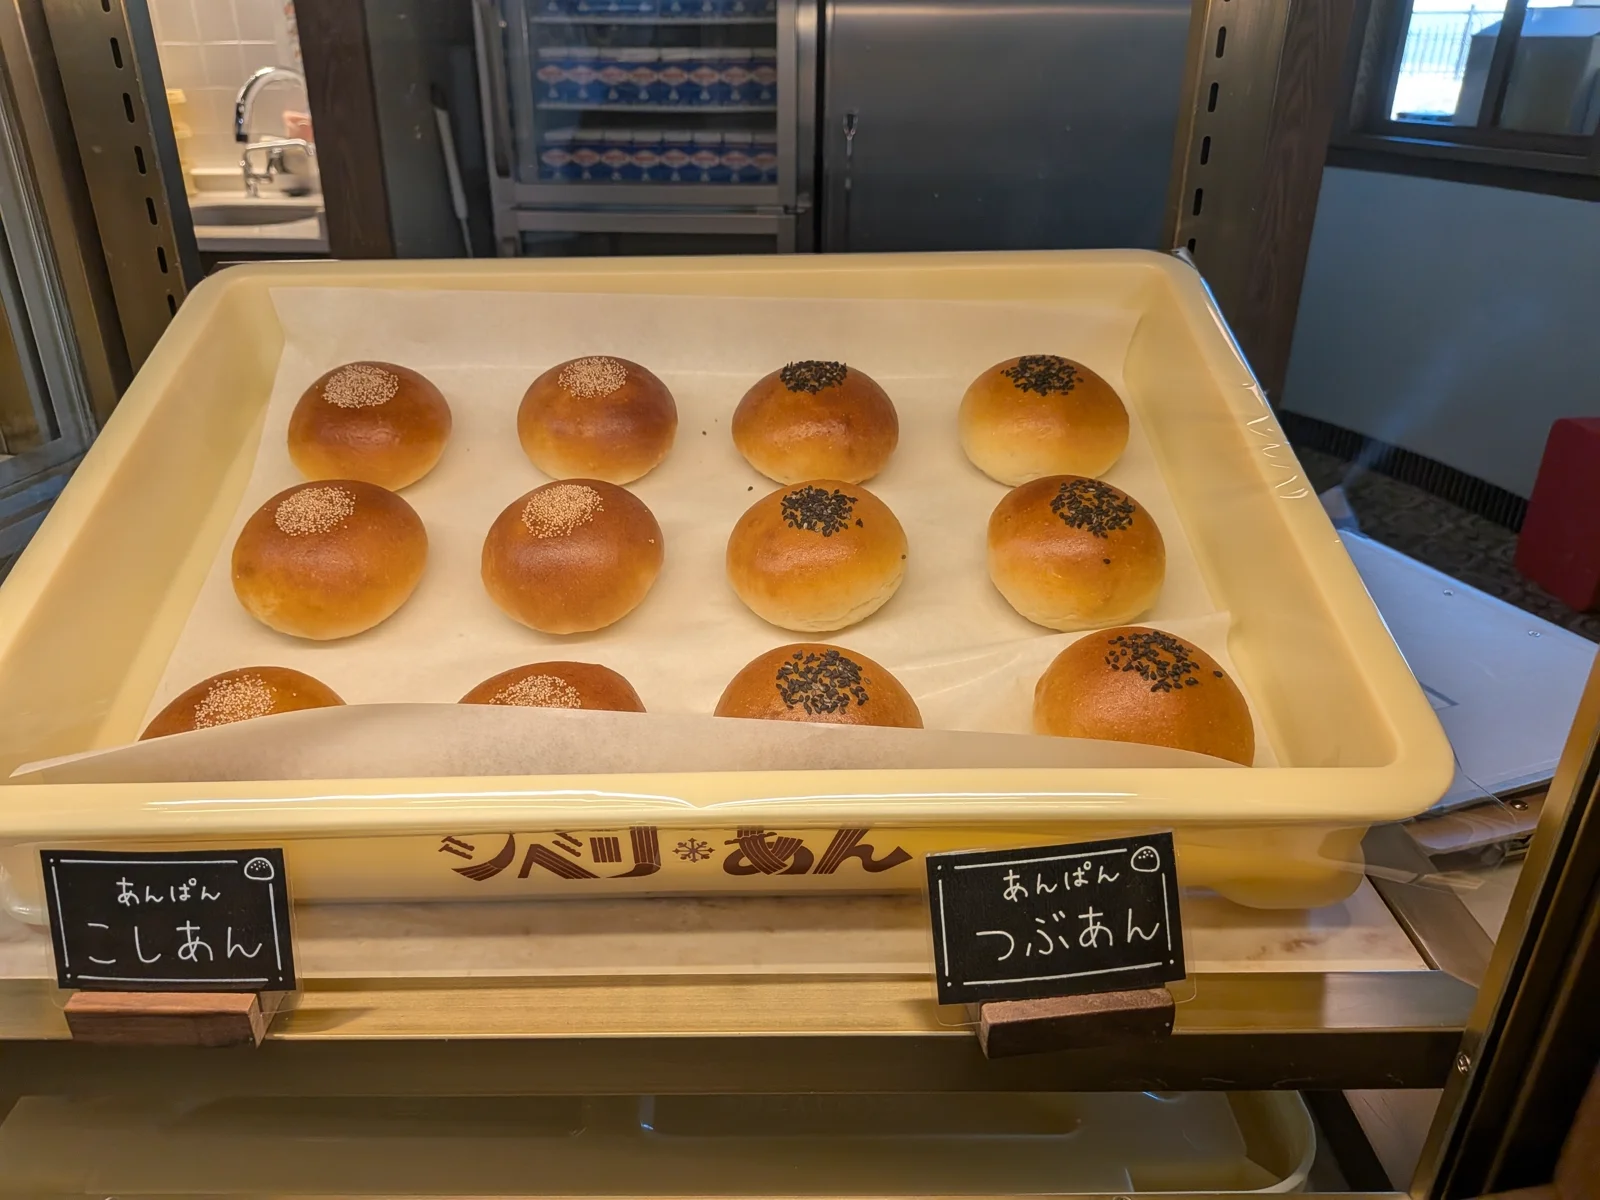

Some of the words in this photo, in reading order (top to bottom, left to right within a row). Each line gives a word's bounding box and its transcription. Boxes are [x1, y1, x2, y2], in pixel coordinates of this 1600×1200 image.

[115, 876, 221, 907] あんぱん
[1003, 860, 1120, 902] あんぱん
[87, 919, 263, 963] こしあん
[975, 905, 1160, 961] つぶあん
